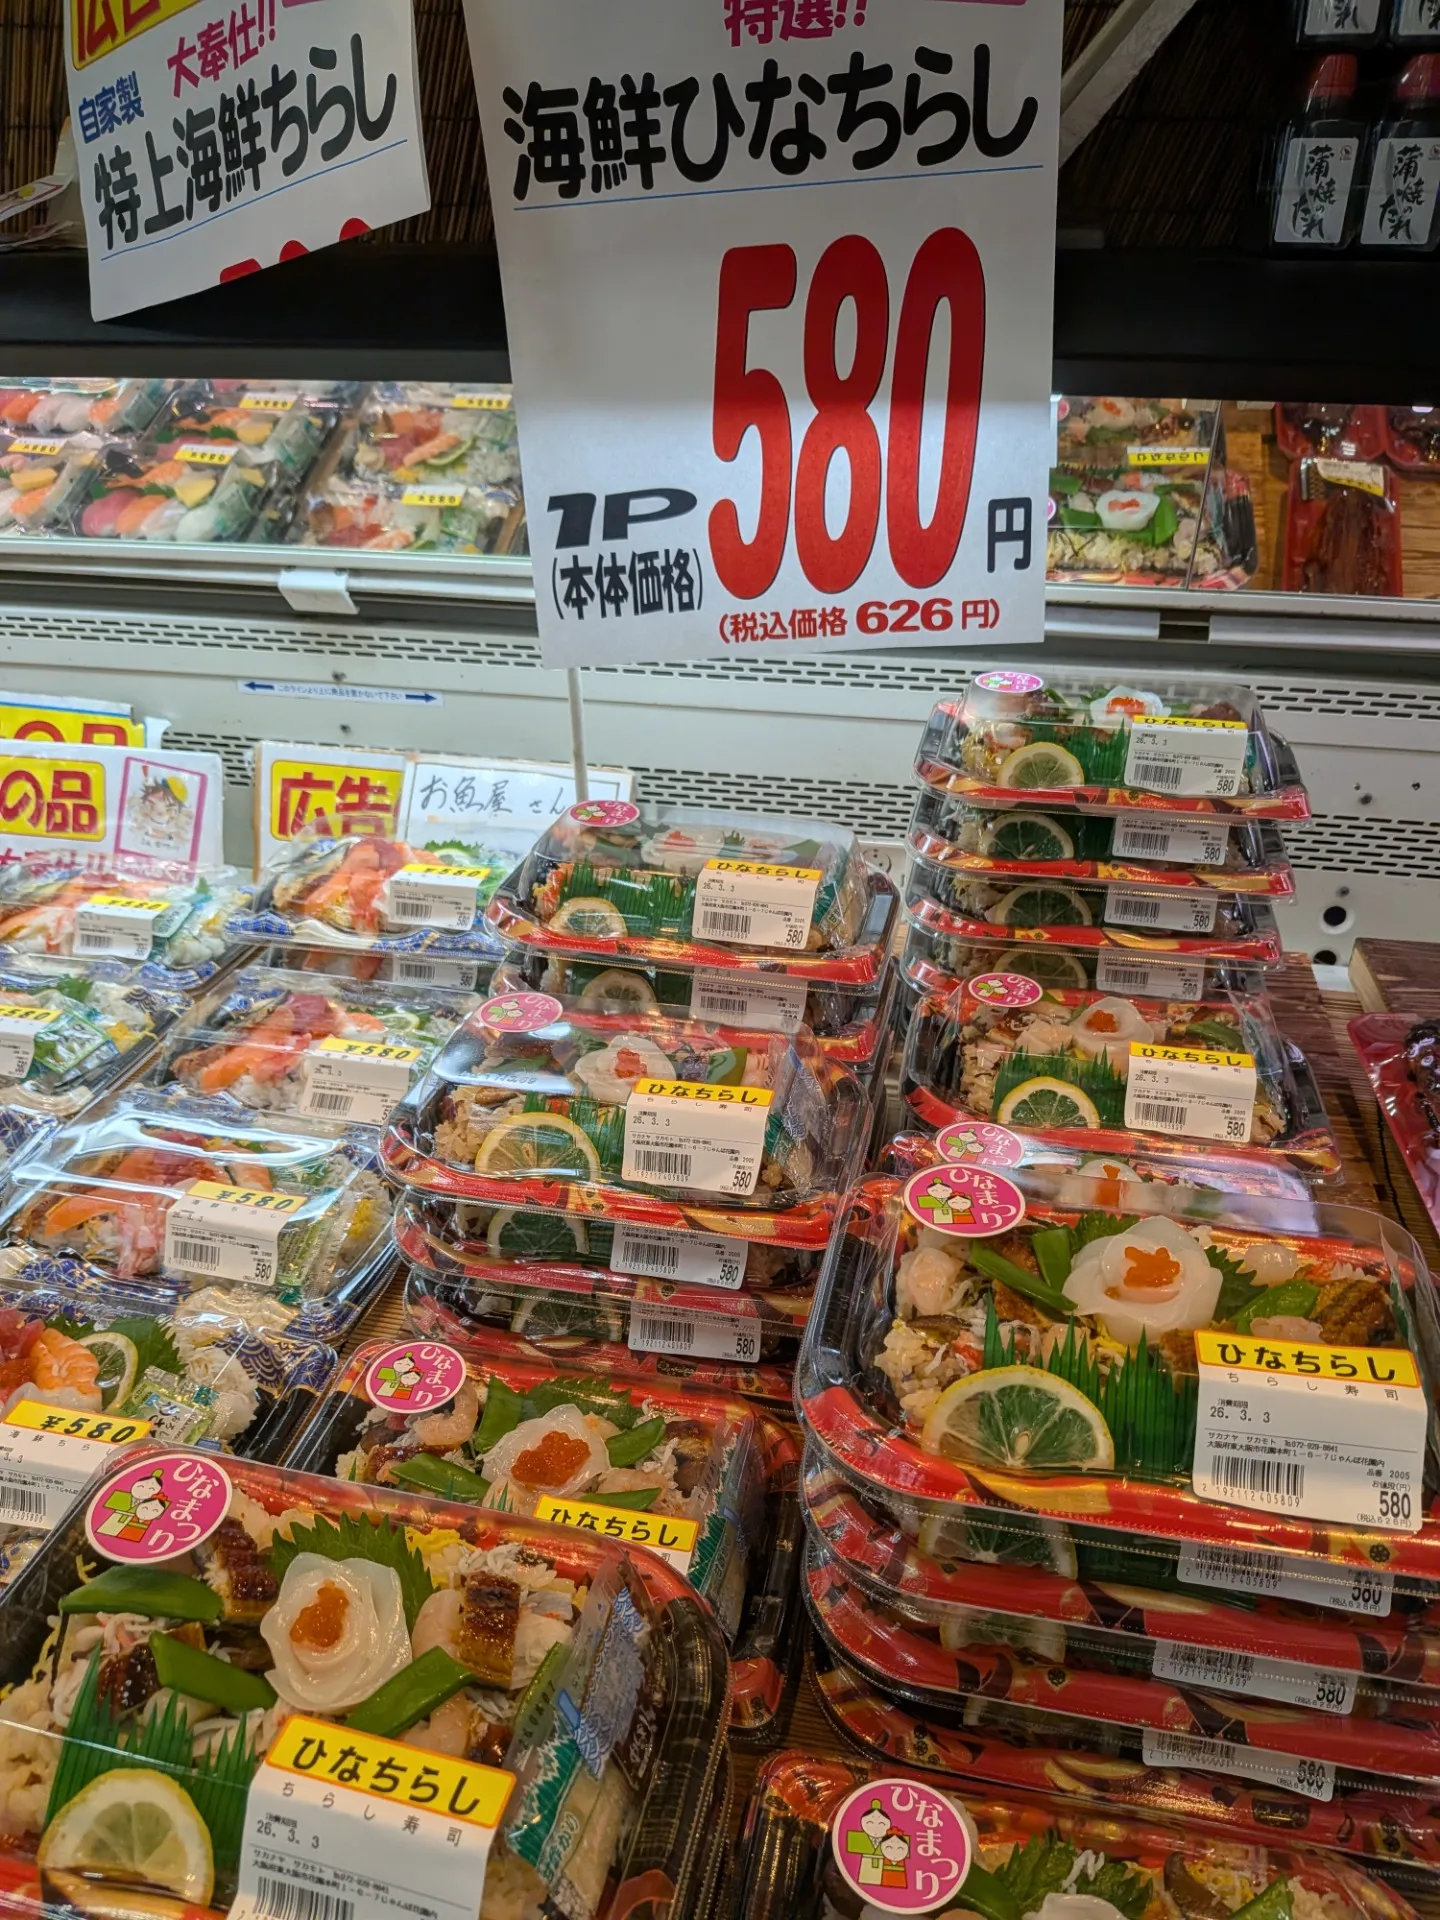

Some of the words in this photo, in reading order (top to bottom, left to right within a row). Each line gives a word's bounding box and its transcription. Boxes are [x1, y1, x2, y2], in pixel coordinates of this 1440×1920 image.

[167, 2, 277, 98] 大奉仕!!
[78, 71, 144, 144] 自家製
[502, 43, 1038, 200] 海鮮ひなちらし
[93, 32, 396, 250] 特上海鮮ちらし
[708, 226, 986, 599] 580
[987, 497, 1032, 573] 円
[546, 488, 698, 550] 1P
[552, 548, 703, 621] (本体価格)
[1216, 780, 1235, 792] 580
[1204, 847, 1221, 861] 580
[717, 862, 809, 878] ひなちらし
[1193, 914, 1210, 928] 580
[786, 929, 804, 944] 580
[344, 1044, 411, 1059] ¥580
[1142, 1047, 1242, 1066] ひなちらし
[649, 1084, 758, 1104] ひなちらし
[1226, 1121, 1245, 1137] 580
[732, 1171, 751, 1188] 580
[216, 1190, 295, 1210] ¥580
[949, 1168, 1016, 1228] ひなまつり
[254, 1263, 272, 1279] 580
[720, 1264, 739, 1281] 580
[736, 1338, 755, 1355] 580
[414, 1345, 456, 1407] ひなまつり
[1217, 1343, 1395, 1381] ひなちらし
[1228, 1372, 1399, 1401] ちらし寿司
[40, 1415, 136, 1443] ¥580
[1209, 1406, 1229, 1419] 26.
[1240, 1409, 1252, 1422] 3.
[1263, 1411, 1270, 1423] 3
[1366, 1468, 1383, 1478] 品番
[1389, 1470, 1410, 1480] 2005
[148, 1460, 220, 1554] ひなまつり
[1379, 1490, 1411, 1519] 580
[550, 1508, 679, 1546] ひなちらし
[292, 1736, 481, 1816] ひなちらし
[282, 1781, 463, 1848] ちらし寿司
[256, 1819, 276, 1838] 26.
[287, 1828, 300, 1844] 3.
[311, 1835, 319, 1849] 3
[892, 1785, 959, 1900] ひなまつり
